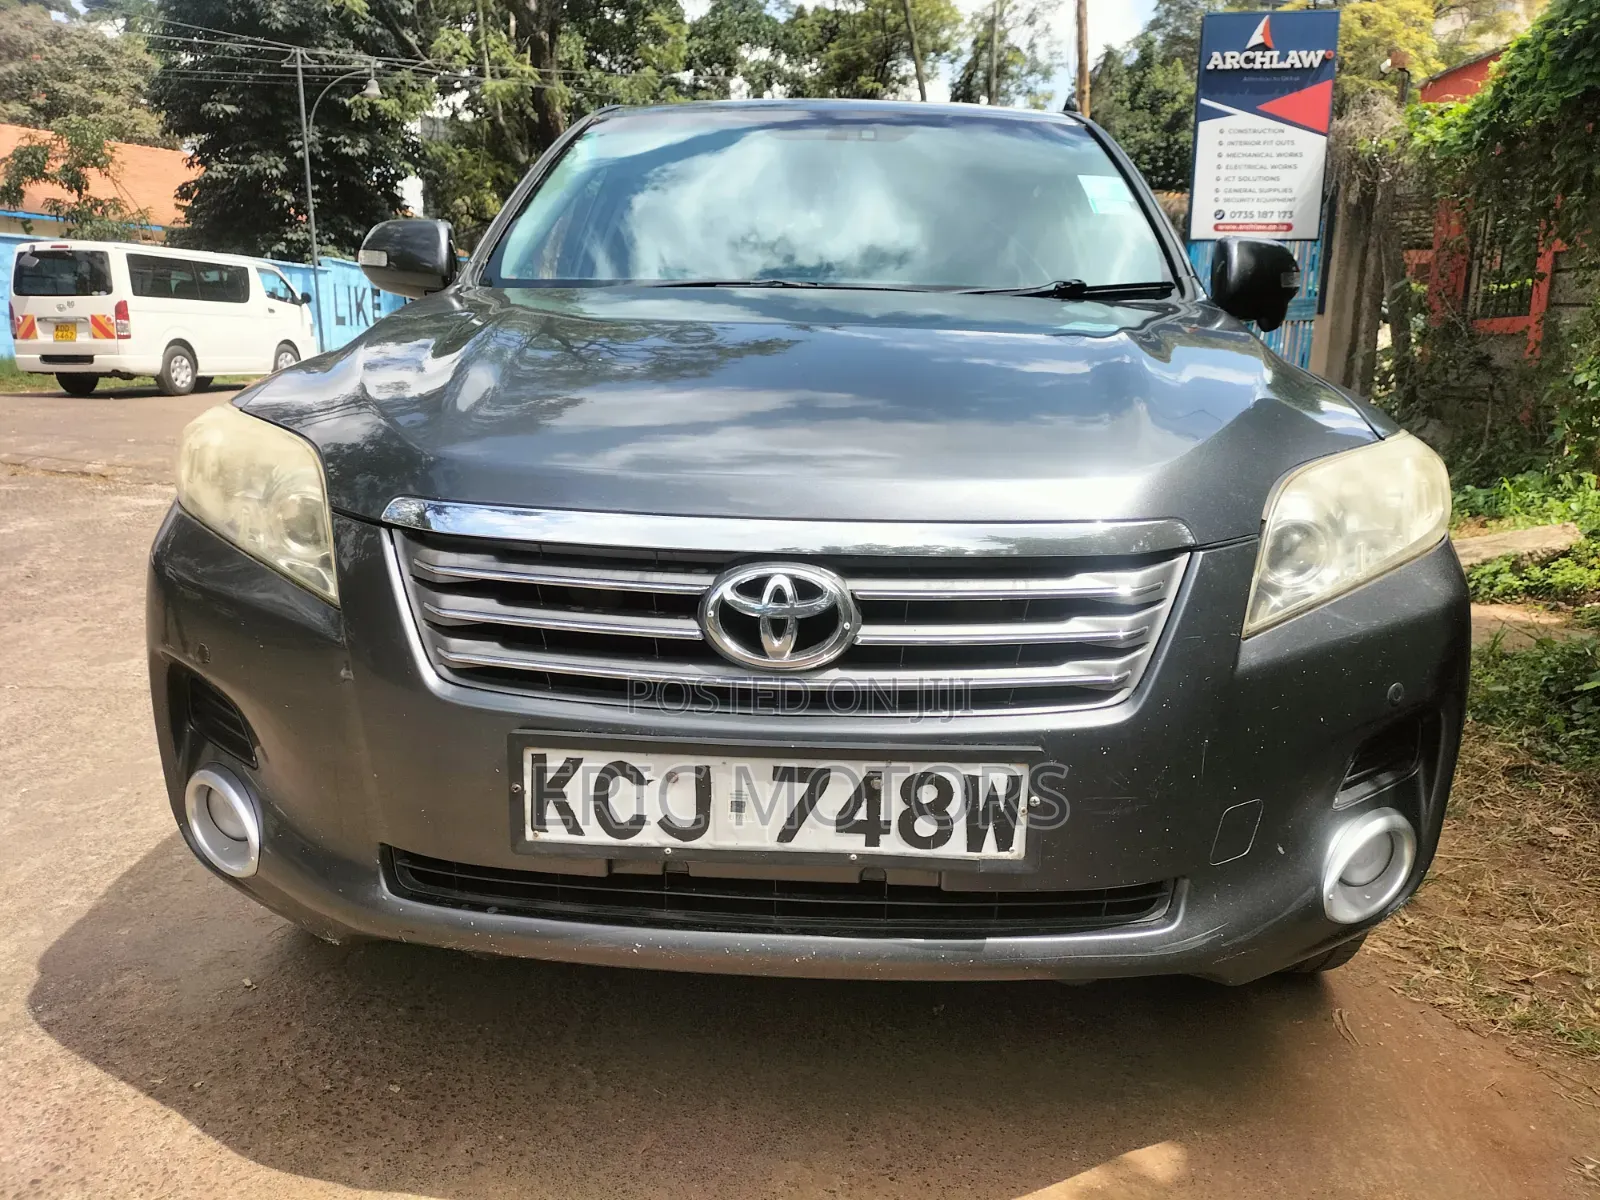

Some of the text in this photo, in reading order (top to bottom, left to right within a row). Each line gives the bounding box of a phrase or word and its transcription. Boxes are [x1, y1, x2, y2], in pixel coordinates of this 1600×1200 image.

[1206, 50, 1325, 70] ARCHLAW
[1229, 210, 1294, 218] 0735 187 173
[530, 753, 1024, 853] KCJ 748W
